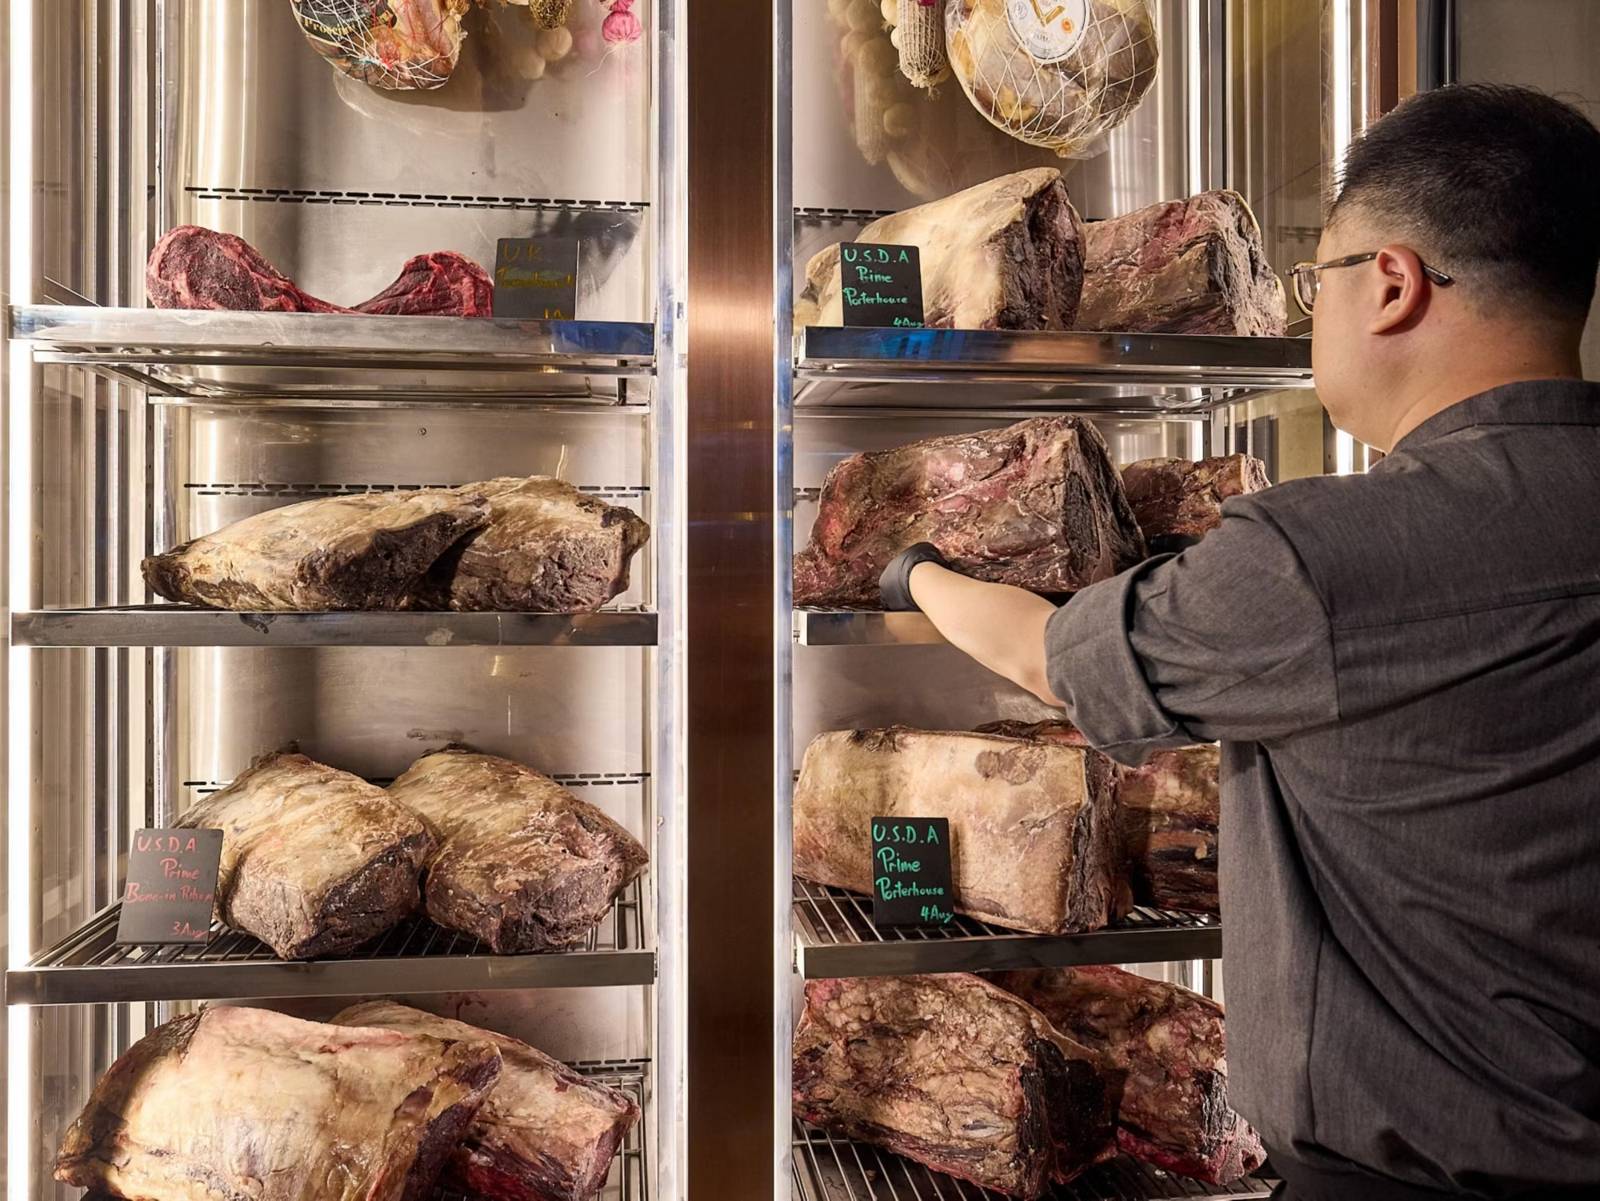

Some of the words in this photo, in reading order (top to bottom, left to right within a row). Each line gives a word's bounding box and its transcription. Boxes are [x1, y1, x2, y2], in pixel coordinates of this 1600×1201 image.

[856, 265, 894, 283] Prime
[843, 287, 908, 307] Porterhouse
[160, 858, 200, 879] Prime
[877, 846, 921, 872] Prime
[875, 877, 945, 901] Porterhouse
